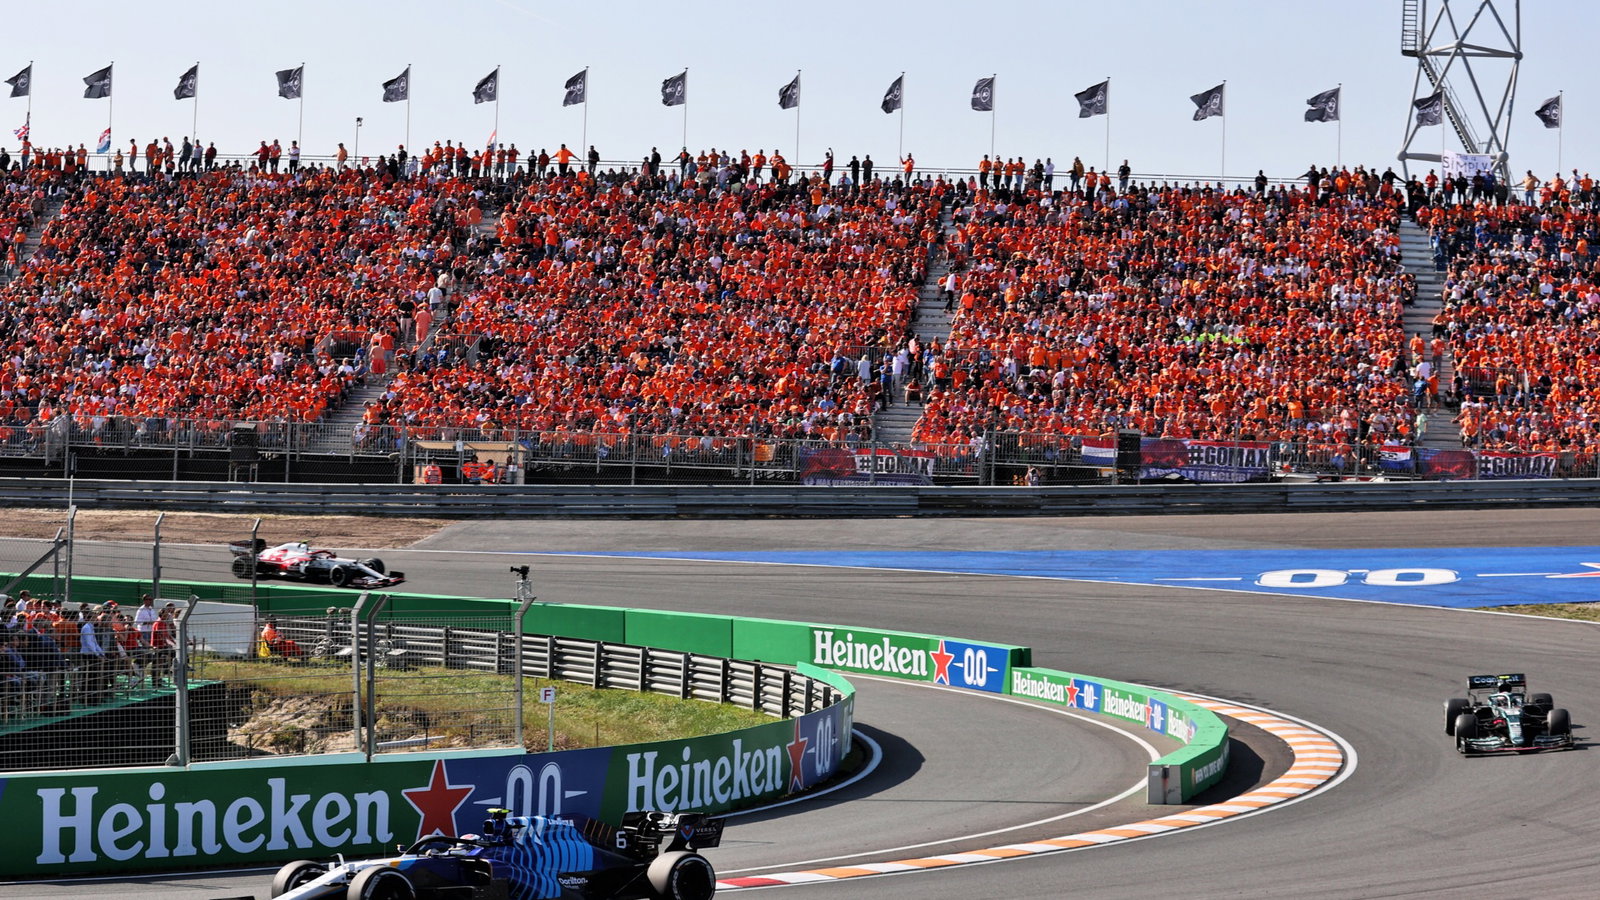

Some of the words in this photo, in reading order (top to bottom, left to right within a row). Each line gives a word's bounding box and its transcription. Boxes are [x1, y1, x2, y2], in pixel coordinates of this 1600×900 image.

[1187, 445, 1270, 468] #GOMAX
[1480, 455, 1556, 476] #GOMAX
[813, 630, 928, 676] Heineken
[963, 647, 988, 687] 0.0
[544, 690, 551, 700] F
[1012, 671, 1065, 702] Heineken
[1103, 688, 1146, 722] Heineken
[626, 738, 783, 814] Heineken
[36, 777, 394, 865] Heineken
[615, 830, 627, 849] 6
